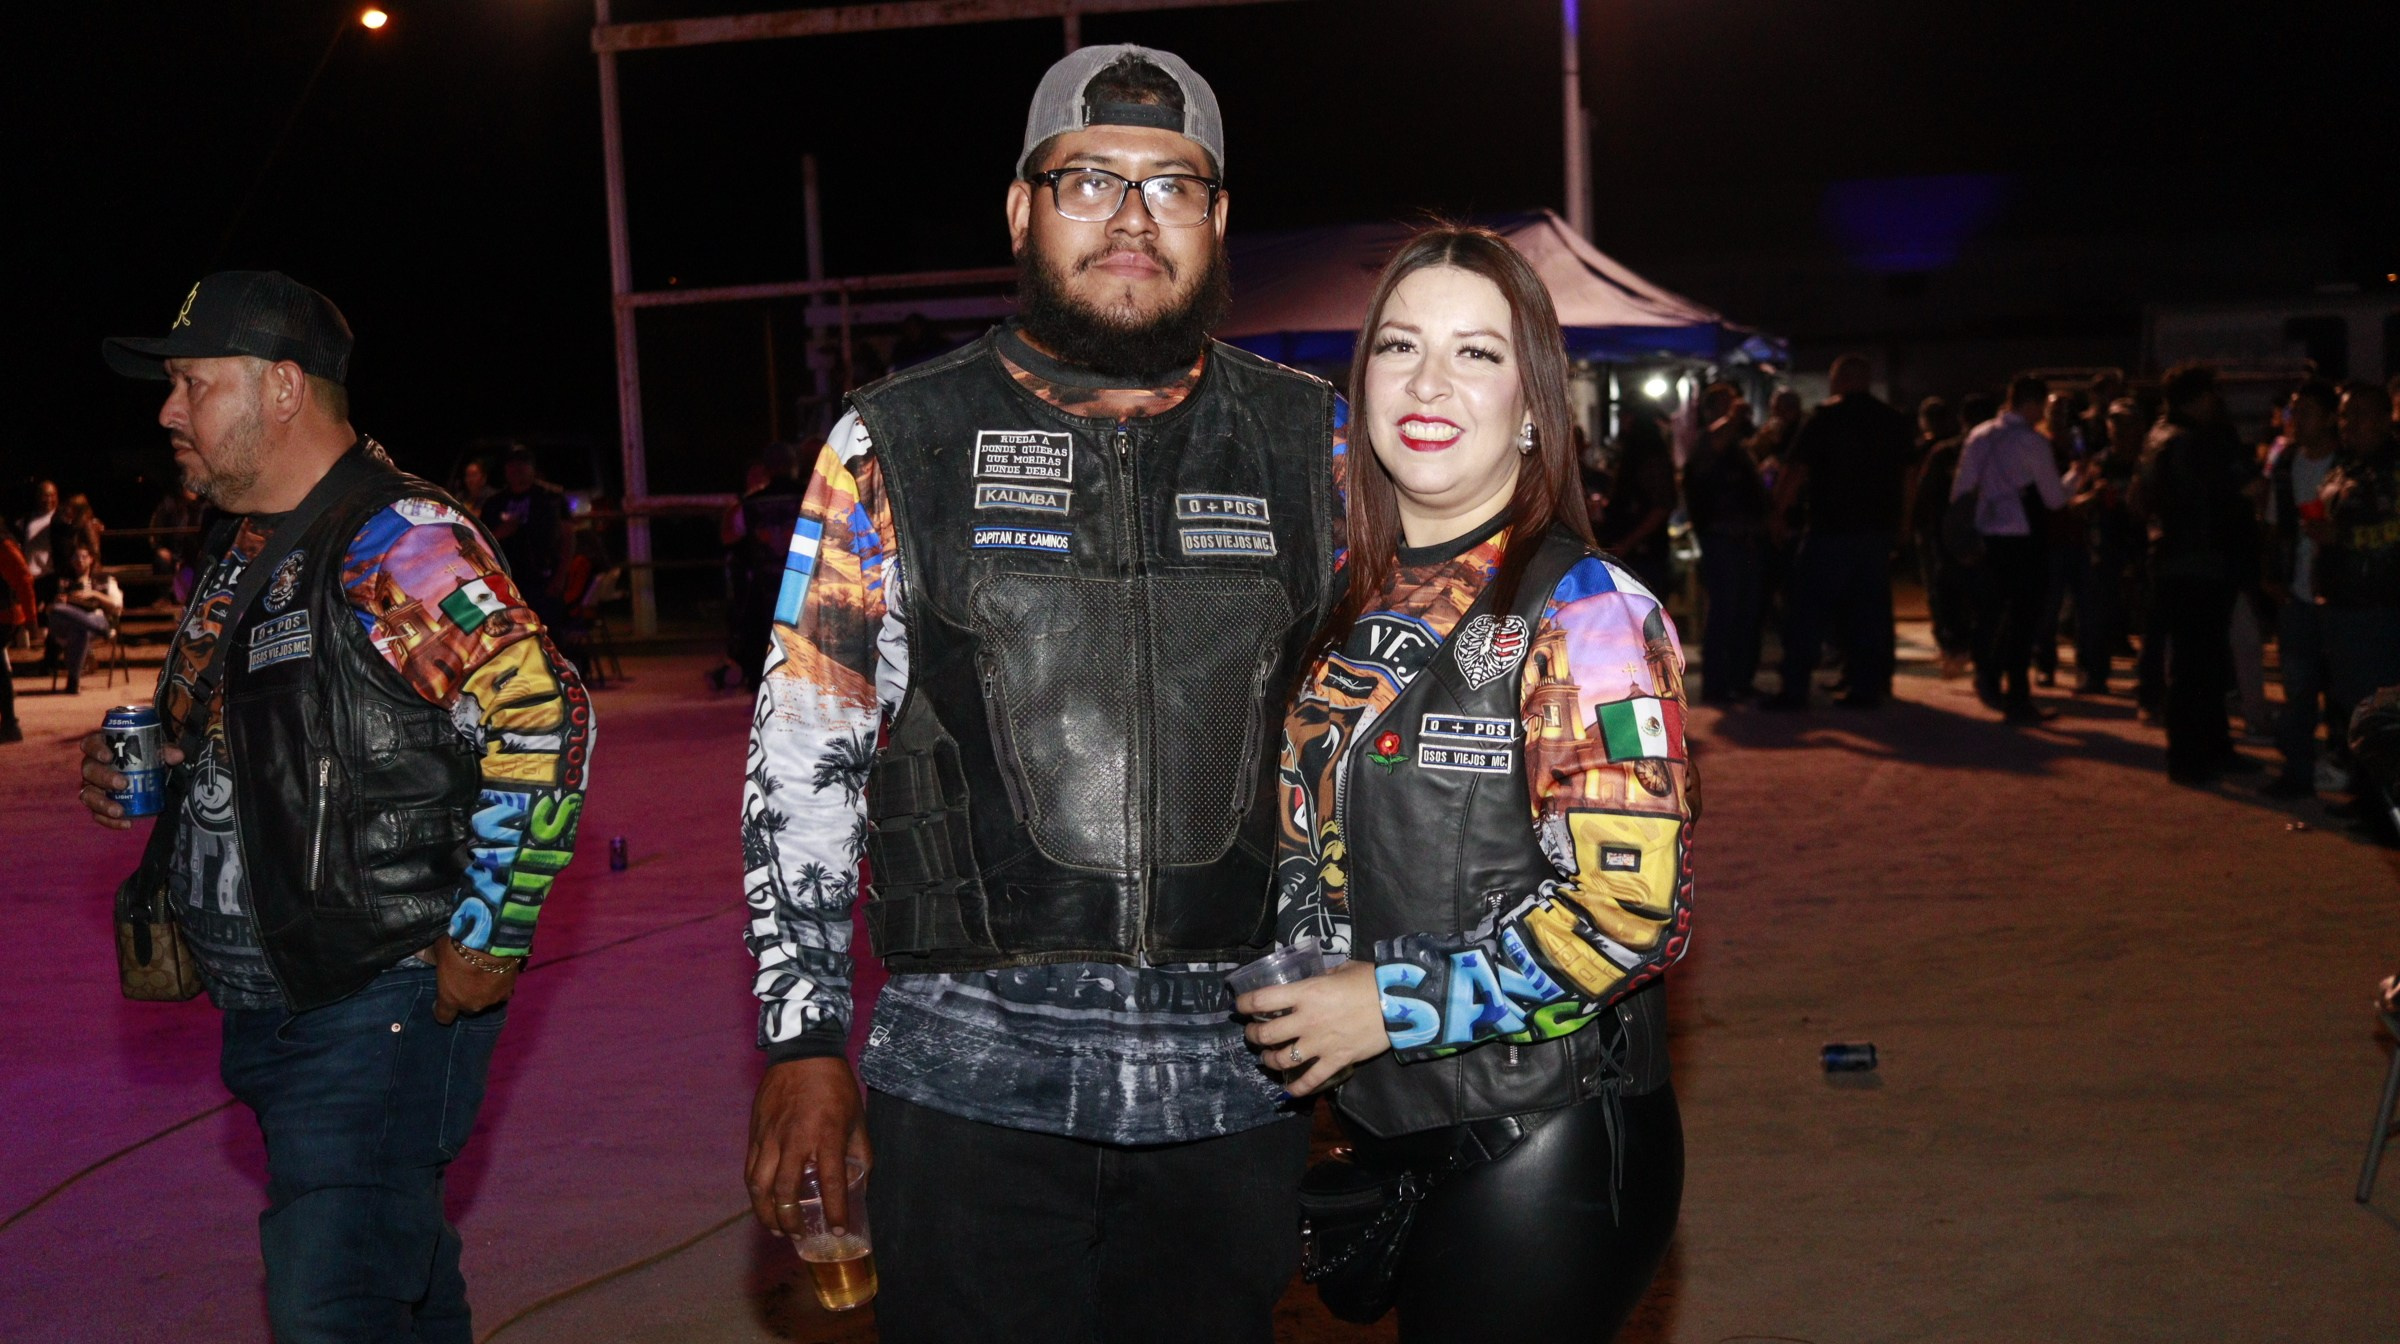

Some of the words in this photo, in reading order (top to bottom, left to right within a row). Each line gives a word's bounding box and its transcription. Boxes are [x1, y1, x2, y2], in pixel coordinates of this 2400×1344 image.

[999, 434, 1037, 444] RUEDA
[1041, 436, 1050, 446] A
[981, 444, 1017, 454] DONDE
[1021, 445, 1068, 457] QUIERAS
[986, 454, 1009, 464] QUE
[1013, 455, 1062, 467] MORIRAS
[984, 464, 1021, 474] DONDE
[1025, 465, 1061, 477] DEBAS
[985, 489, 1057, 506] KALIMBA
[1222, 500, 1257, 516] POS
[974, 530, 1012, 545] CAPITAN
[1014, 532, 1027, 545] DE
[1029, 532, 1069, 549] CAMINOS
[1185, 534, 1215, 549] OSOS
[1214, 533, 1252, 549] VIEJOS
[277, 616, 301, 633] POS
[268, 639, 293, 660] VIEJOS
[1474, 723, 1506, 736] POS
[1423, 749, 1447, 763] OSOS
[1453, 751, 1485, 766] VIEJOS
